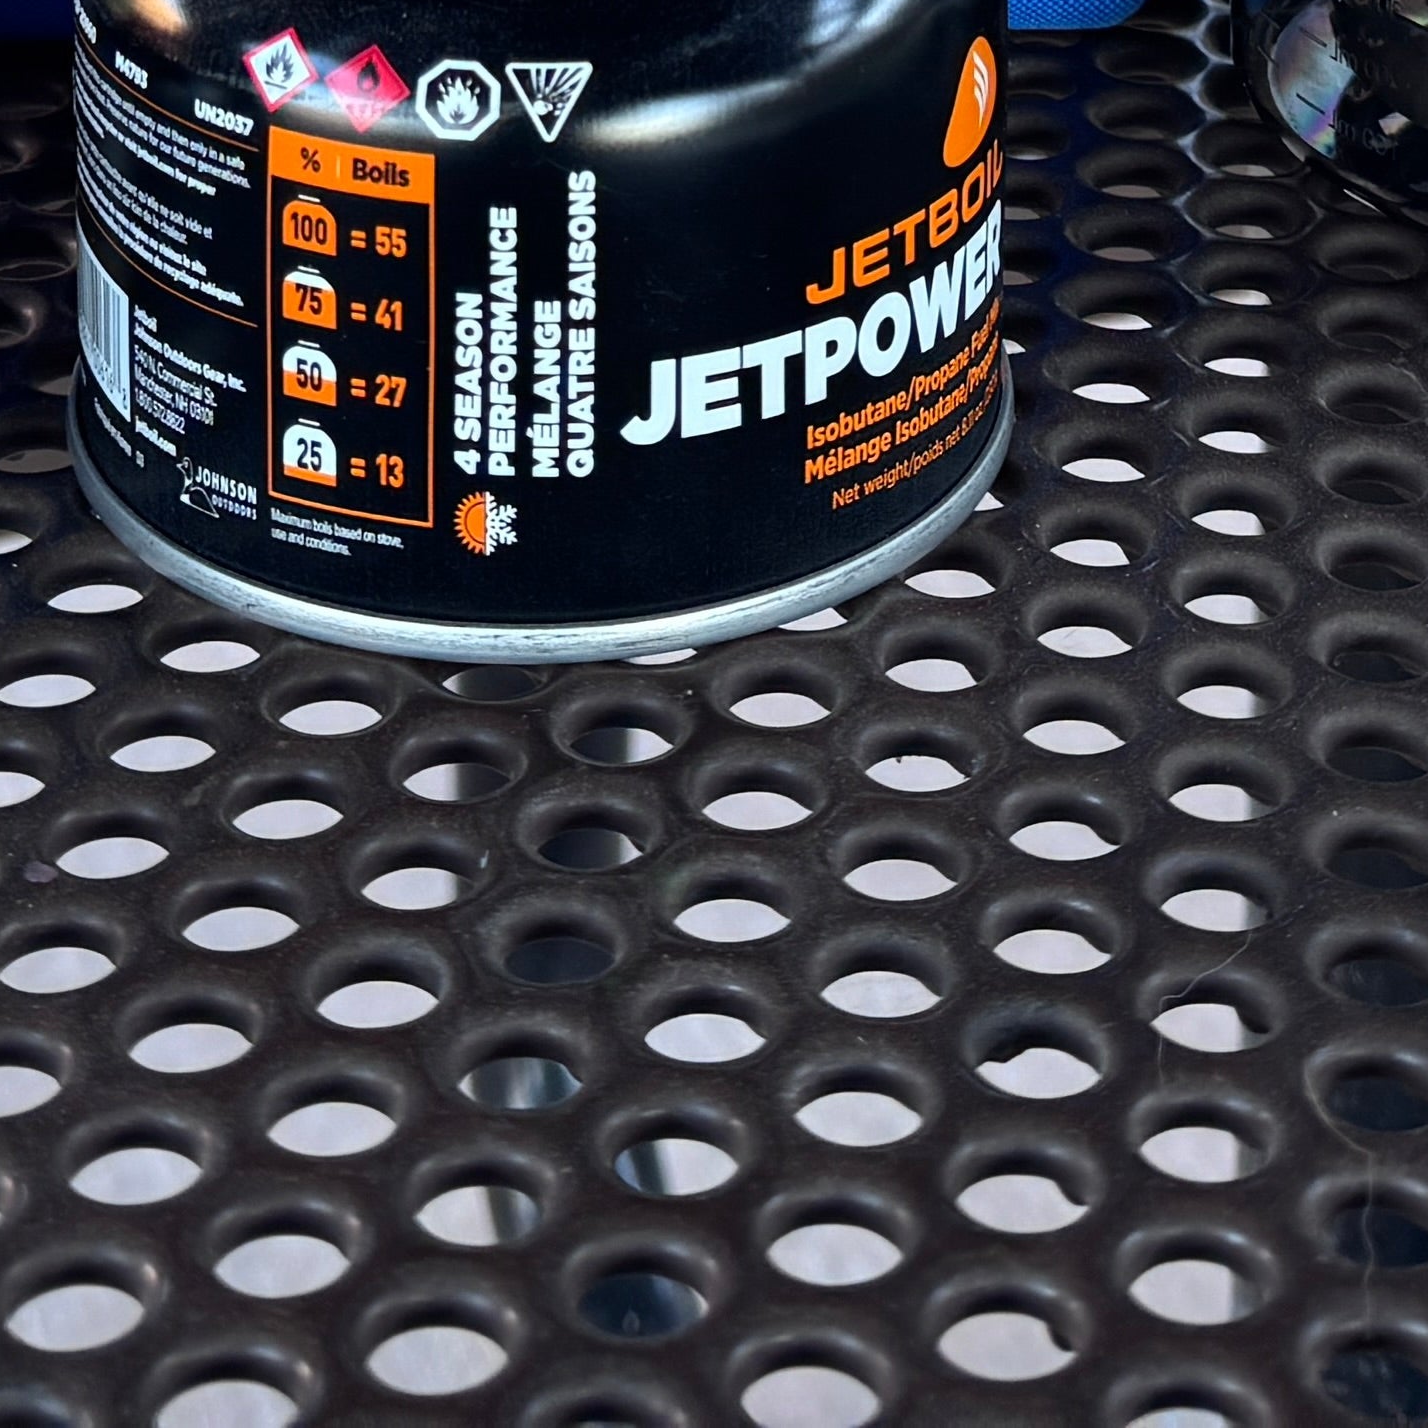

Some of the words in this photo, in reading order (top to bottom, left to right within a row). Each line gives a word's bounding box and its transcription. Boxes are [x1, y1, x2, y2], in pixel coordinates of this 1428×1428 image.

[194, 98, 255, 137] UN2037
[351, 156, 411, 187] Boils
[290, 211, 329, 246] 100
[375, 226, 408, 258] 55
[568, 170, 596, 321] SAISONS
[805, 138, 1003, 305] JETBOIL
[295, 283, 323, 316] 75
[375, 299, 403, 332] 41
[619, 198, 1002, 445] JETPOWER
[134, 322, 163, 354] Johnson
[163, 341, 202, 376] Outdoors
[227, 372, 247, 393] Inc.
[488, 207, 518, 476] PERFORMANCE
[157, 360, 203, 400] Commercial
[295, 358, 323, 393] 50
[375, 375, 408, 408] 27
[454, 292, 483, 442] SEASON
[526, 300, 561, 478] MÉLANGE
[566, 328, 595, 478] QUATRE
[807, 346, 971, 450] Isobutane/Propane
[296, 438, 323, 472] 25
[375, 454, 404, 488] 13
[453, 450, 481, 475] 4
[804, 431, 892, 484] Mélange
[832, 482, 860, 511] Net
[864, 436, 944, 495] weight/poids
[195, 465, 258, 505] JOHNSON
[212, 494, 258, 521] OUTDOORS
[270, 507, 313, 530] Maximum
[313, 518, 333, 536] boils
[334, 523, 362, 541] based
[363, 531, 376, 544] on
[288, 532, 304, 545] and
